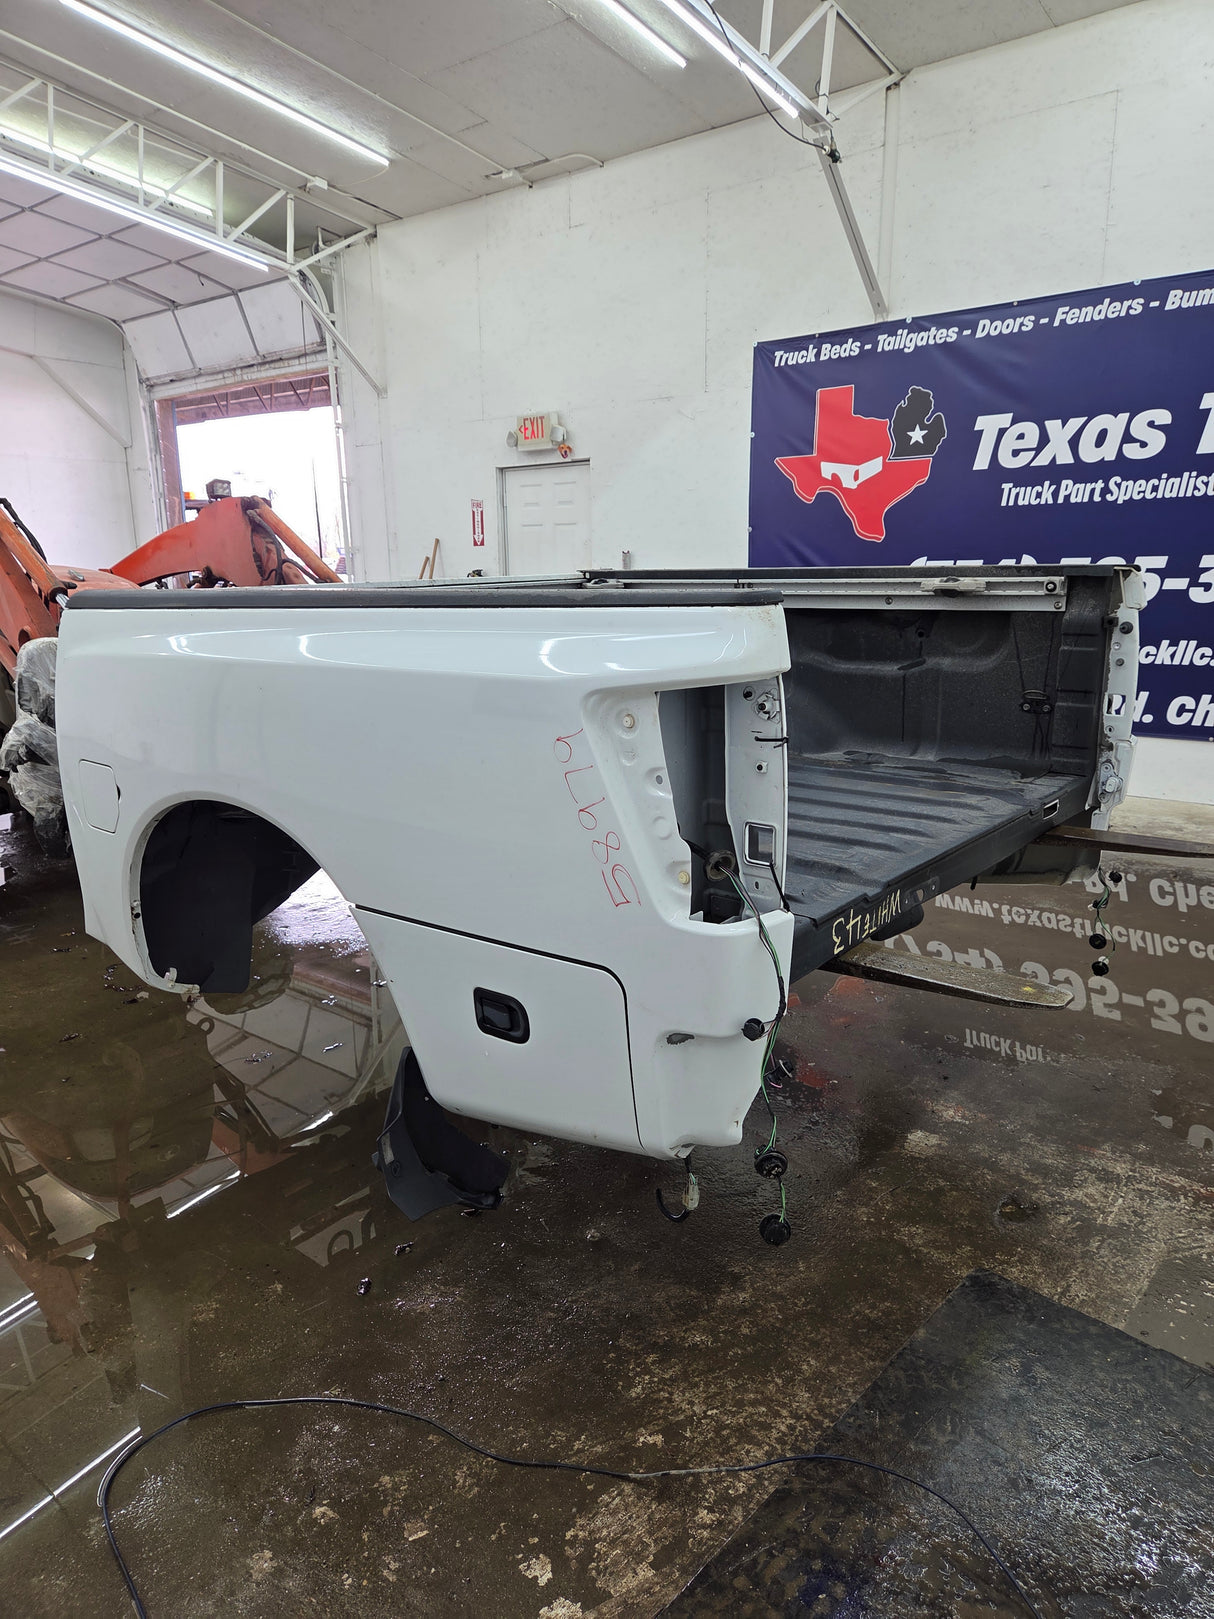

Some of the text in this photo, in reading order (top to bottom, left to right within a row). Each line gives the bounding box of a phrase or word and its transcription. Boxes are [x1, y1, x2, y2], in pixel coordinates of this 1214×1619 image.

[774, 346, 816, 367] Truck
[820, 338, 861, 361] Beds
[877, 325, 959, 353] Tailgates
[976, 312, 1035, 339] Doors
[1053, 297, 1145, 327] Fenders
[1164, 286, 1214, 311] Bum
[523, 416, 545, 441] EXIT
[972, 408, 1173, 471] Texas
[1000, 480, 1054, 507] Truck
[1057, 479, 1105, 503] Part
